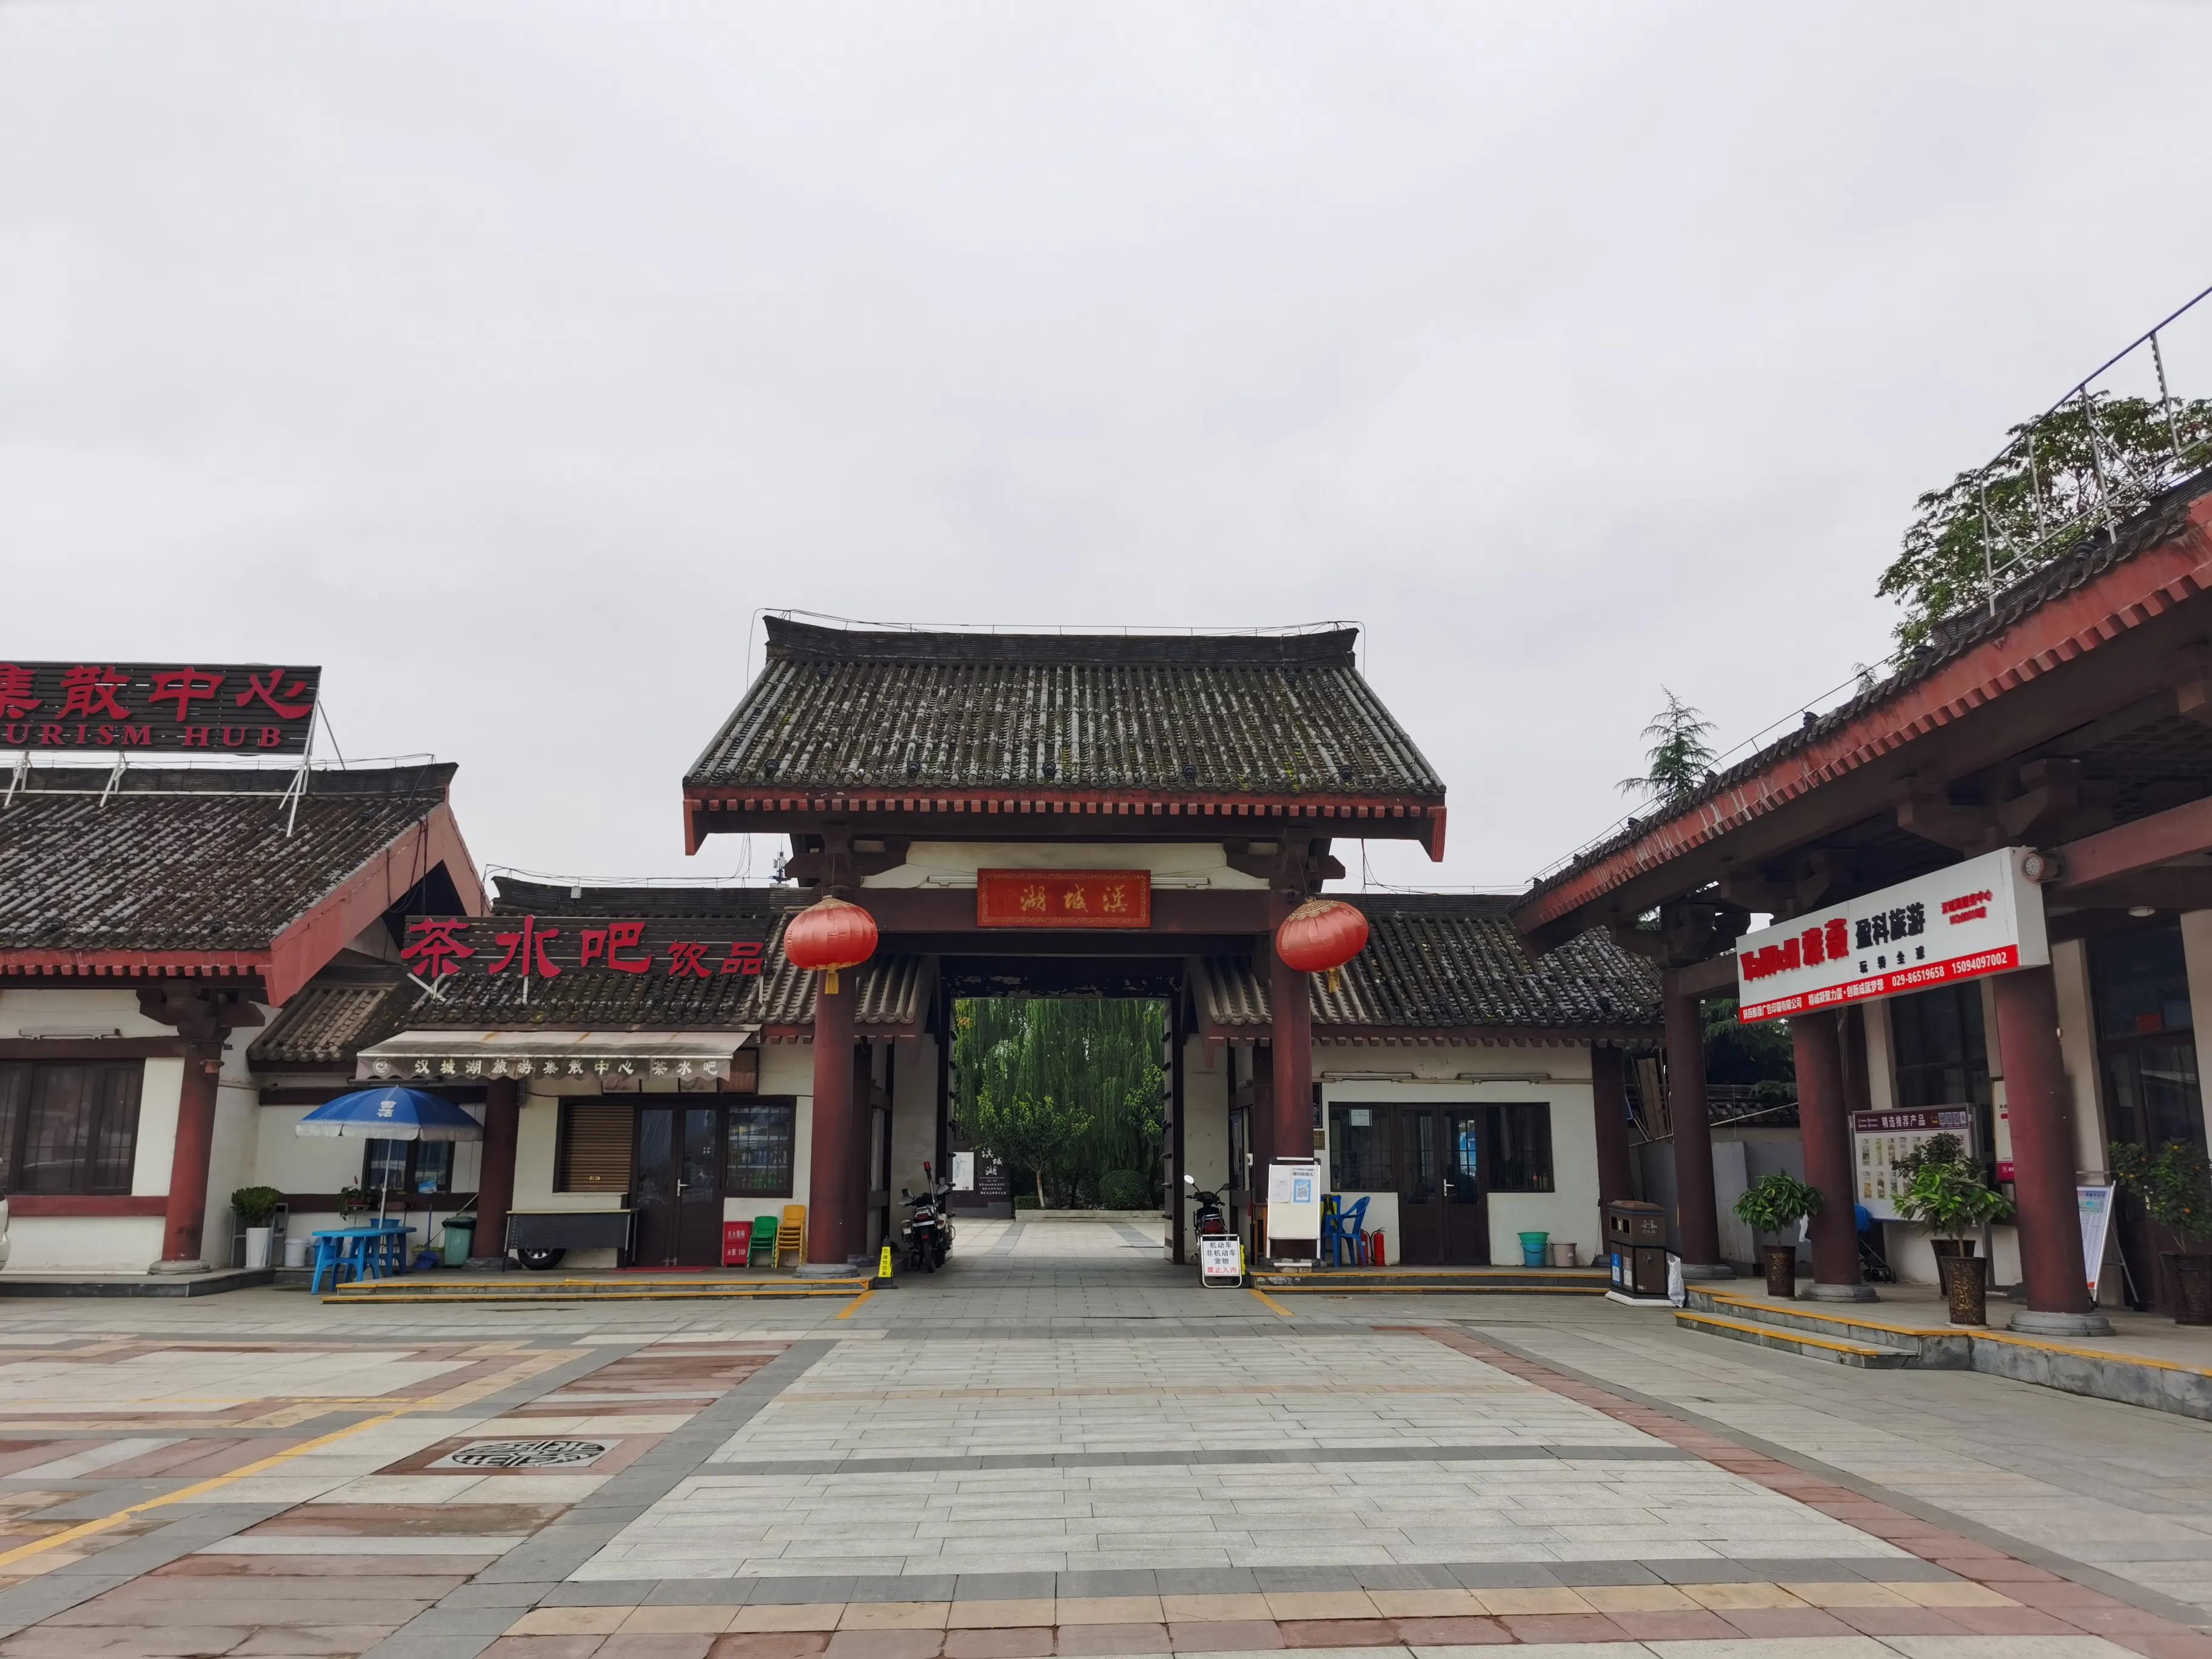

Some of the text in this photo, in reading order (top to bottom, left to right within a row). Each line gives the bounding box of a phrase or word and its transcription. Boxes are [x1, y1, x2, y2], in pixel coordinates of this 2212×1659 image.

[182, 726, 283, 747] HUB
[401, 914, 765, 978] 茶水吧 饮品
[1891, 965, 1945, 987] 029-86519658
[1951, 951, 2008, 974] 15094097002
[414, 1059, 718, 1076] 汉城湖旅游集散中心 茶水吧
[1881, 1114, 1926, 1128] 精选推荐产品
